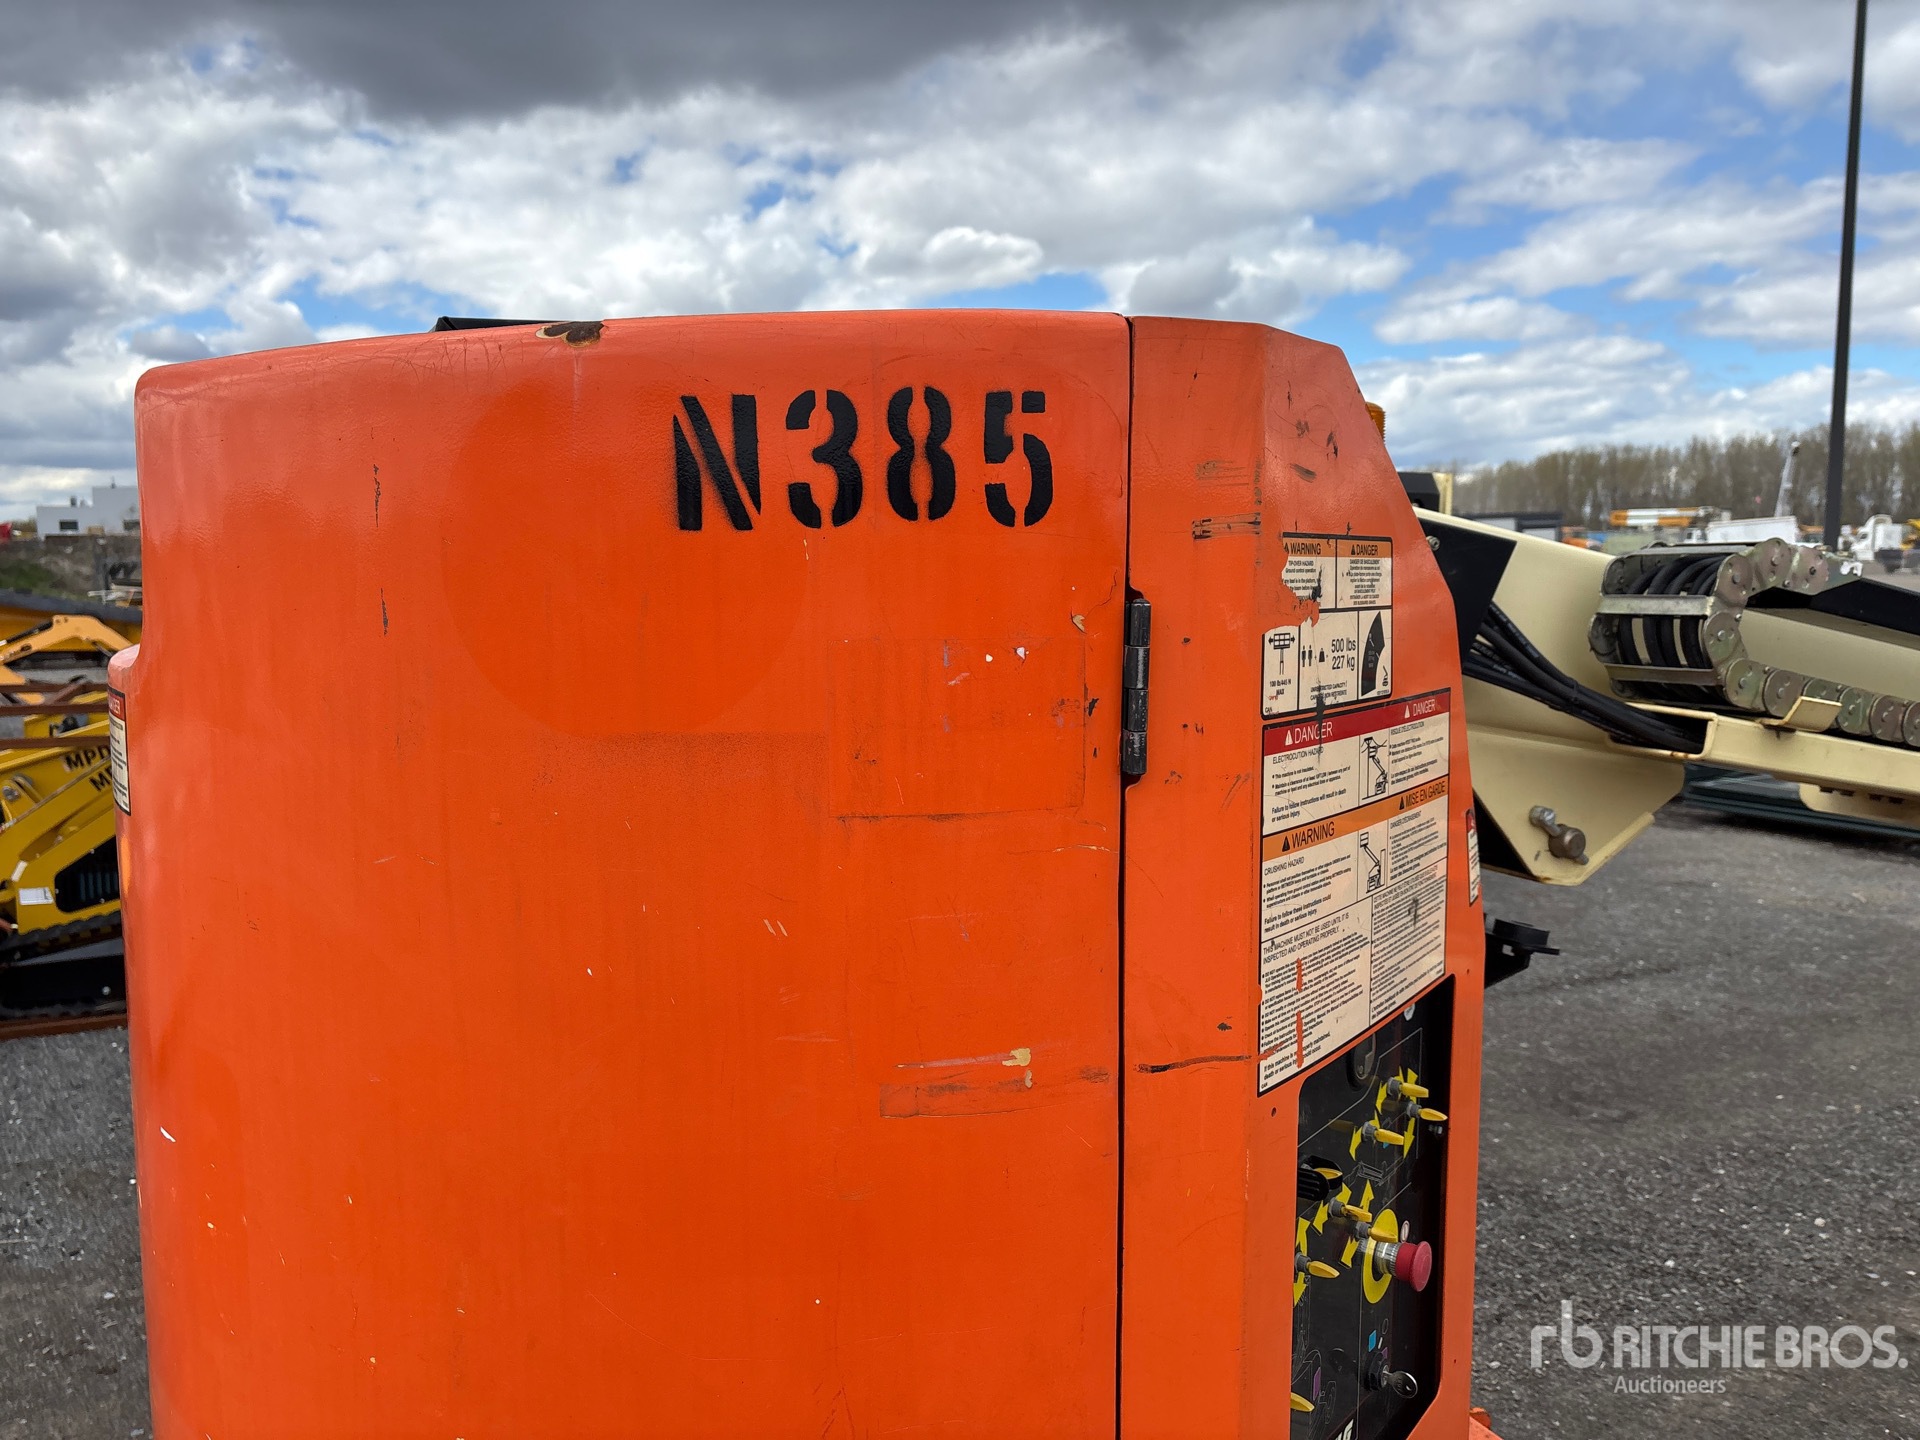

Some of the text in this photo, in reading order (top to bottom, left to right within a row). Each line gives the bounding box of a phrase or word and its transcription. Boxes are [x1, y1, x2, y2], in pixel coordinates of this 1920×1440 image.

[673, 386, 1053, 531] N385
[1291, 543, 1320, 555] WARNING
[1356, 544, 1378, 556] DANGER
[1331, 637, 1356, 653] 500 lbs
[1332, 654, 1355, 671] 227 kg
[1413, 699, 1436, 716] DANGER
[1295, 722, 1333, 744] DANGER
[1273, 750, 1307, 764] ELECTROCUTION
[1272, 805, 1284, 815] Failure
[1289, 801, 1299, 810] follow
[1300, 795, 1319, 807] instructions
[1326, 791, 1334, 799] result
[1406, 781, 1446, 807] MISE EN GARDE
[1277, 813, 1289, 822] serious
[1292, 821, 1334, 848] WARNING
[1264, 857, 1304, 876] CRUSHING HAZARD
[1265, 914, 1277, 925] Failure
[1282, 908, 1292, 918] follow
[1293, 904, 1302, 914] these
[1303, 896, 1322, 910] instructions
[1323, 892, 1331, 902] could
[1265, 924, 1275, 934] result
[1280, 918, 1289, 928] death
[1295, 911, 1307, 921] serious
[1264, 944, 1273, 955] THIS
[1275, 936, 1293, 951] MACHINE
[1294, 931, 1305, 942] MUST
[1306, 927, 1314, 937] NOT
[1315, 925, 1320, 933] BE
[1321, 920, 1330, 931] USED
[1346, 913, 1349, 921] IS
[1264, 948, 1287, 966] INSPECTED
[1288, 944, 1297, 955] AND
[1298, 934, 1319, 950] OPERATING
[1275, 1053, 1289, 1066] machine
[1264, 1071, 1274, 1081] death
[1280, 1061, 1292, 1072] serious
